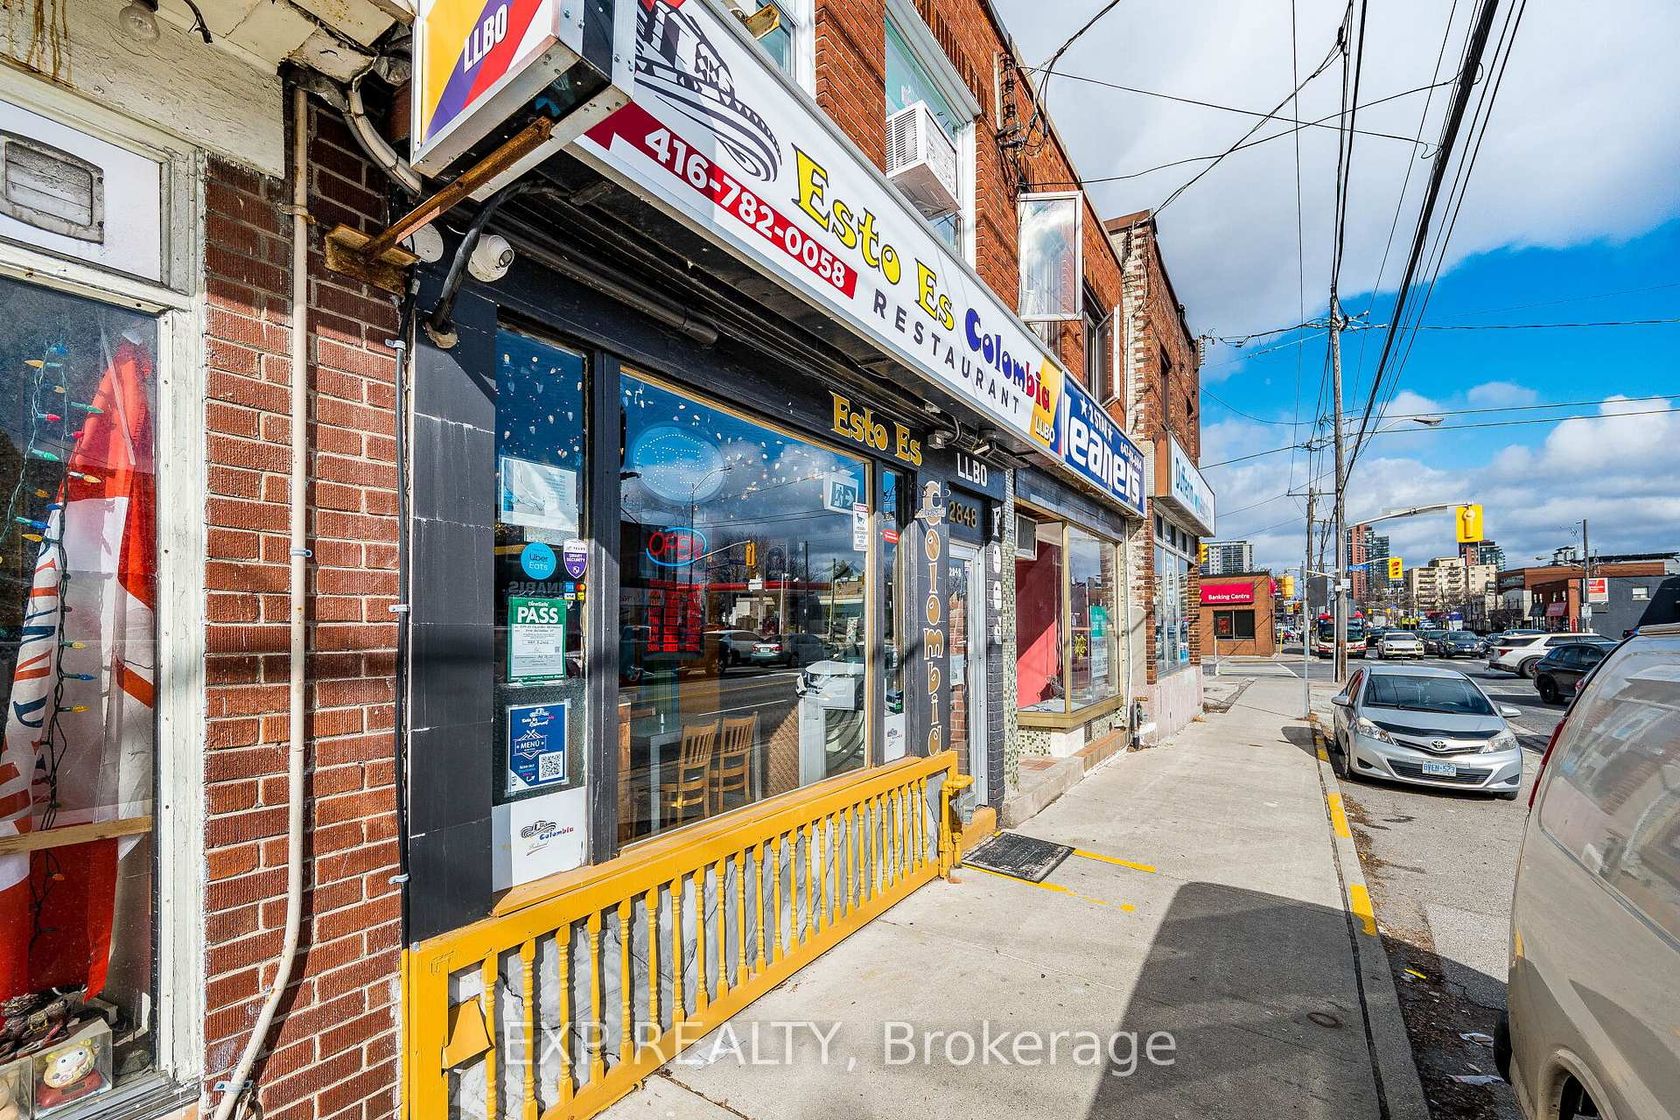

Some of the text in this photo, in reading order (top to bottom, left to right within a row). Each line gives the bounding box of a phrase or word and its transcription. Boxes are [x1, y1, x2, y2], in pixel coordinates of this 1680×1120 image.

[463, 12, 508, 74] LLBO
[644, 127, 847, 289] 416-782-0058
[791, 142, 1050, 414] Esto Es Colombia
[873, 288, 1021, 416] RESTAURANT
[829, 390, 923, 467] Esto Es
[1035, 415, 1056, 444] LLBO
[957, 452, 988, 488] LLBO
[949, 501, 977, 528] 2848
[529, 553, 548, 562] Uber
[648, 531, 705, 560] OPEN
[529, 561, 548, 571] Eats
[517, 606, 559, 624] PASS
